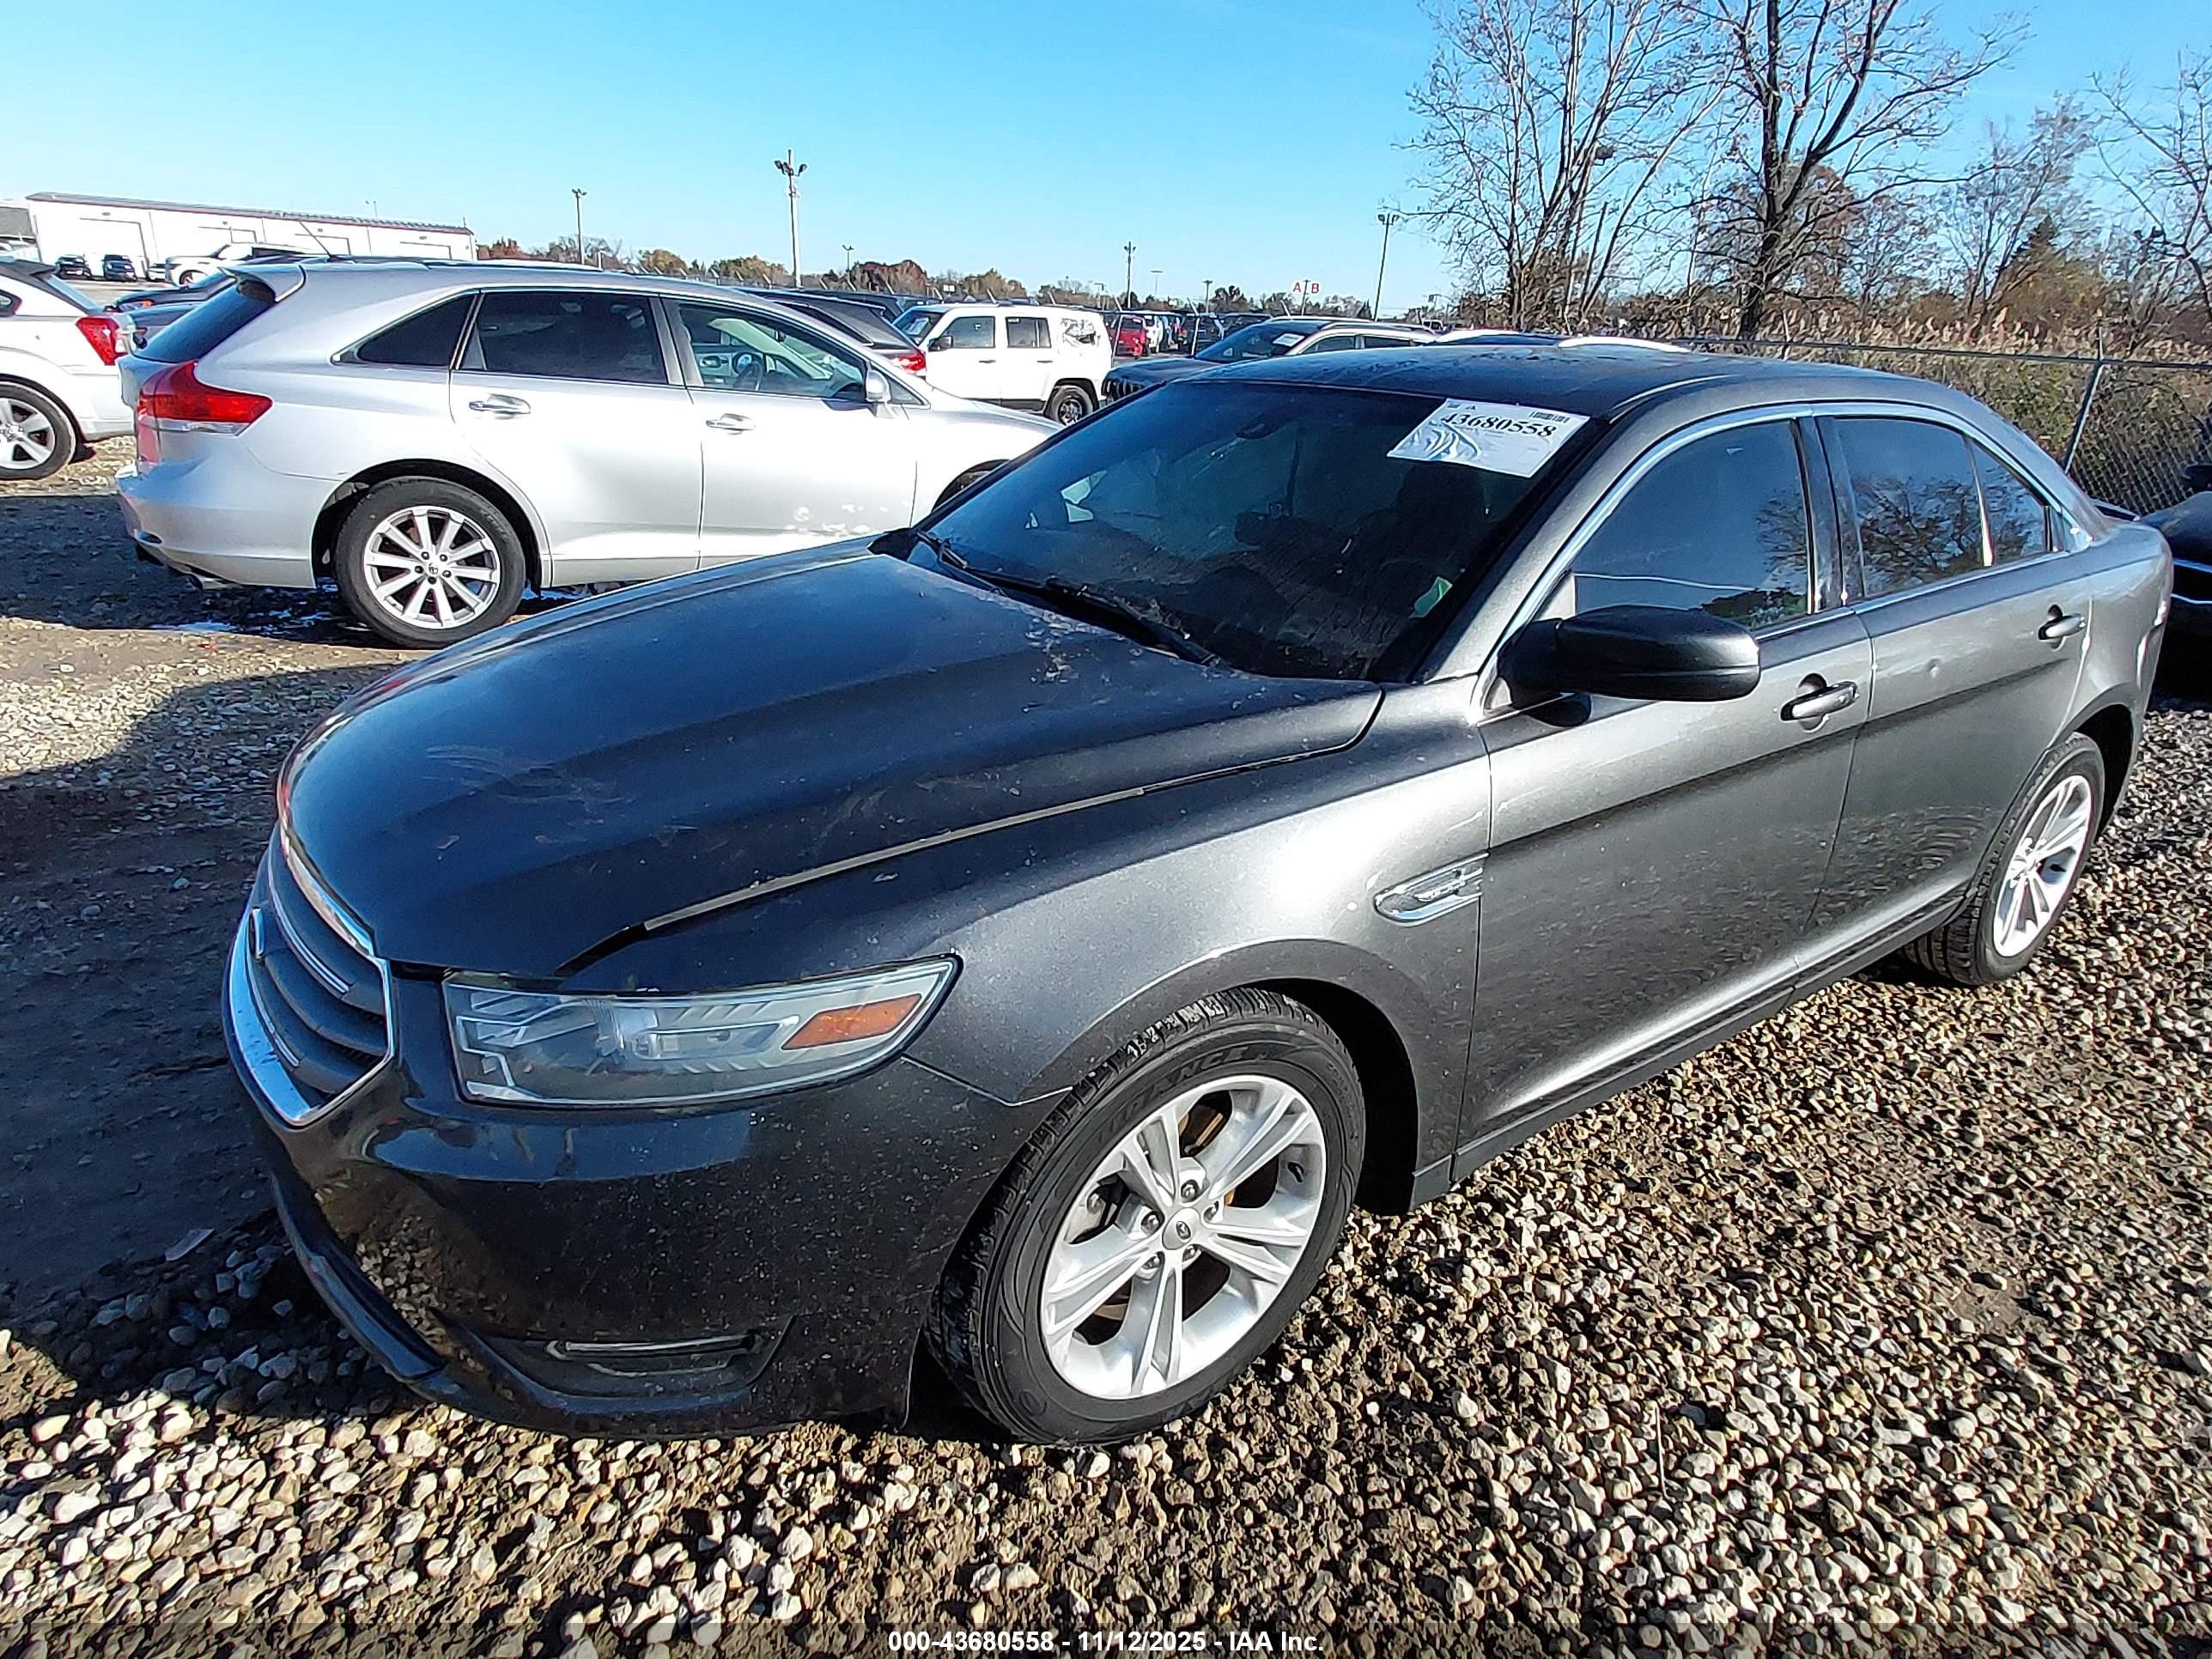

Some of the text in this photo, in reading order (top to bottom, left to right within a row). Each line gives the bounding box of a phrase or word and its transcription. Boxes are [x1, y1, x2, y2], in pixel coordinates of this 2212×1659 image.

[1292, 282, 1302, 293] A
[1311, 283, 1320, 294] B
[1441, 412, 1558, 438] 43680558
